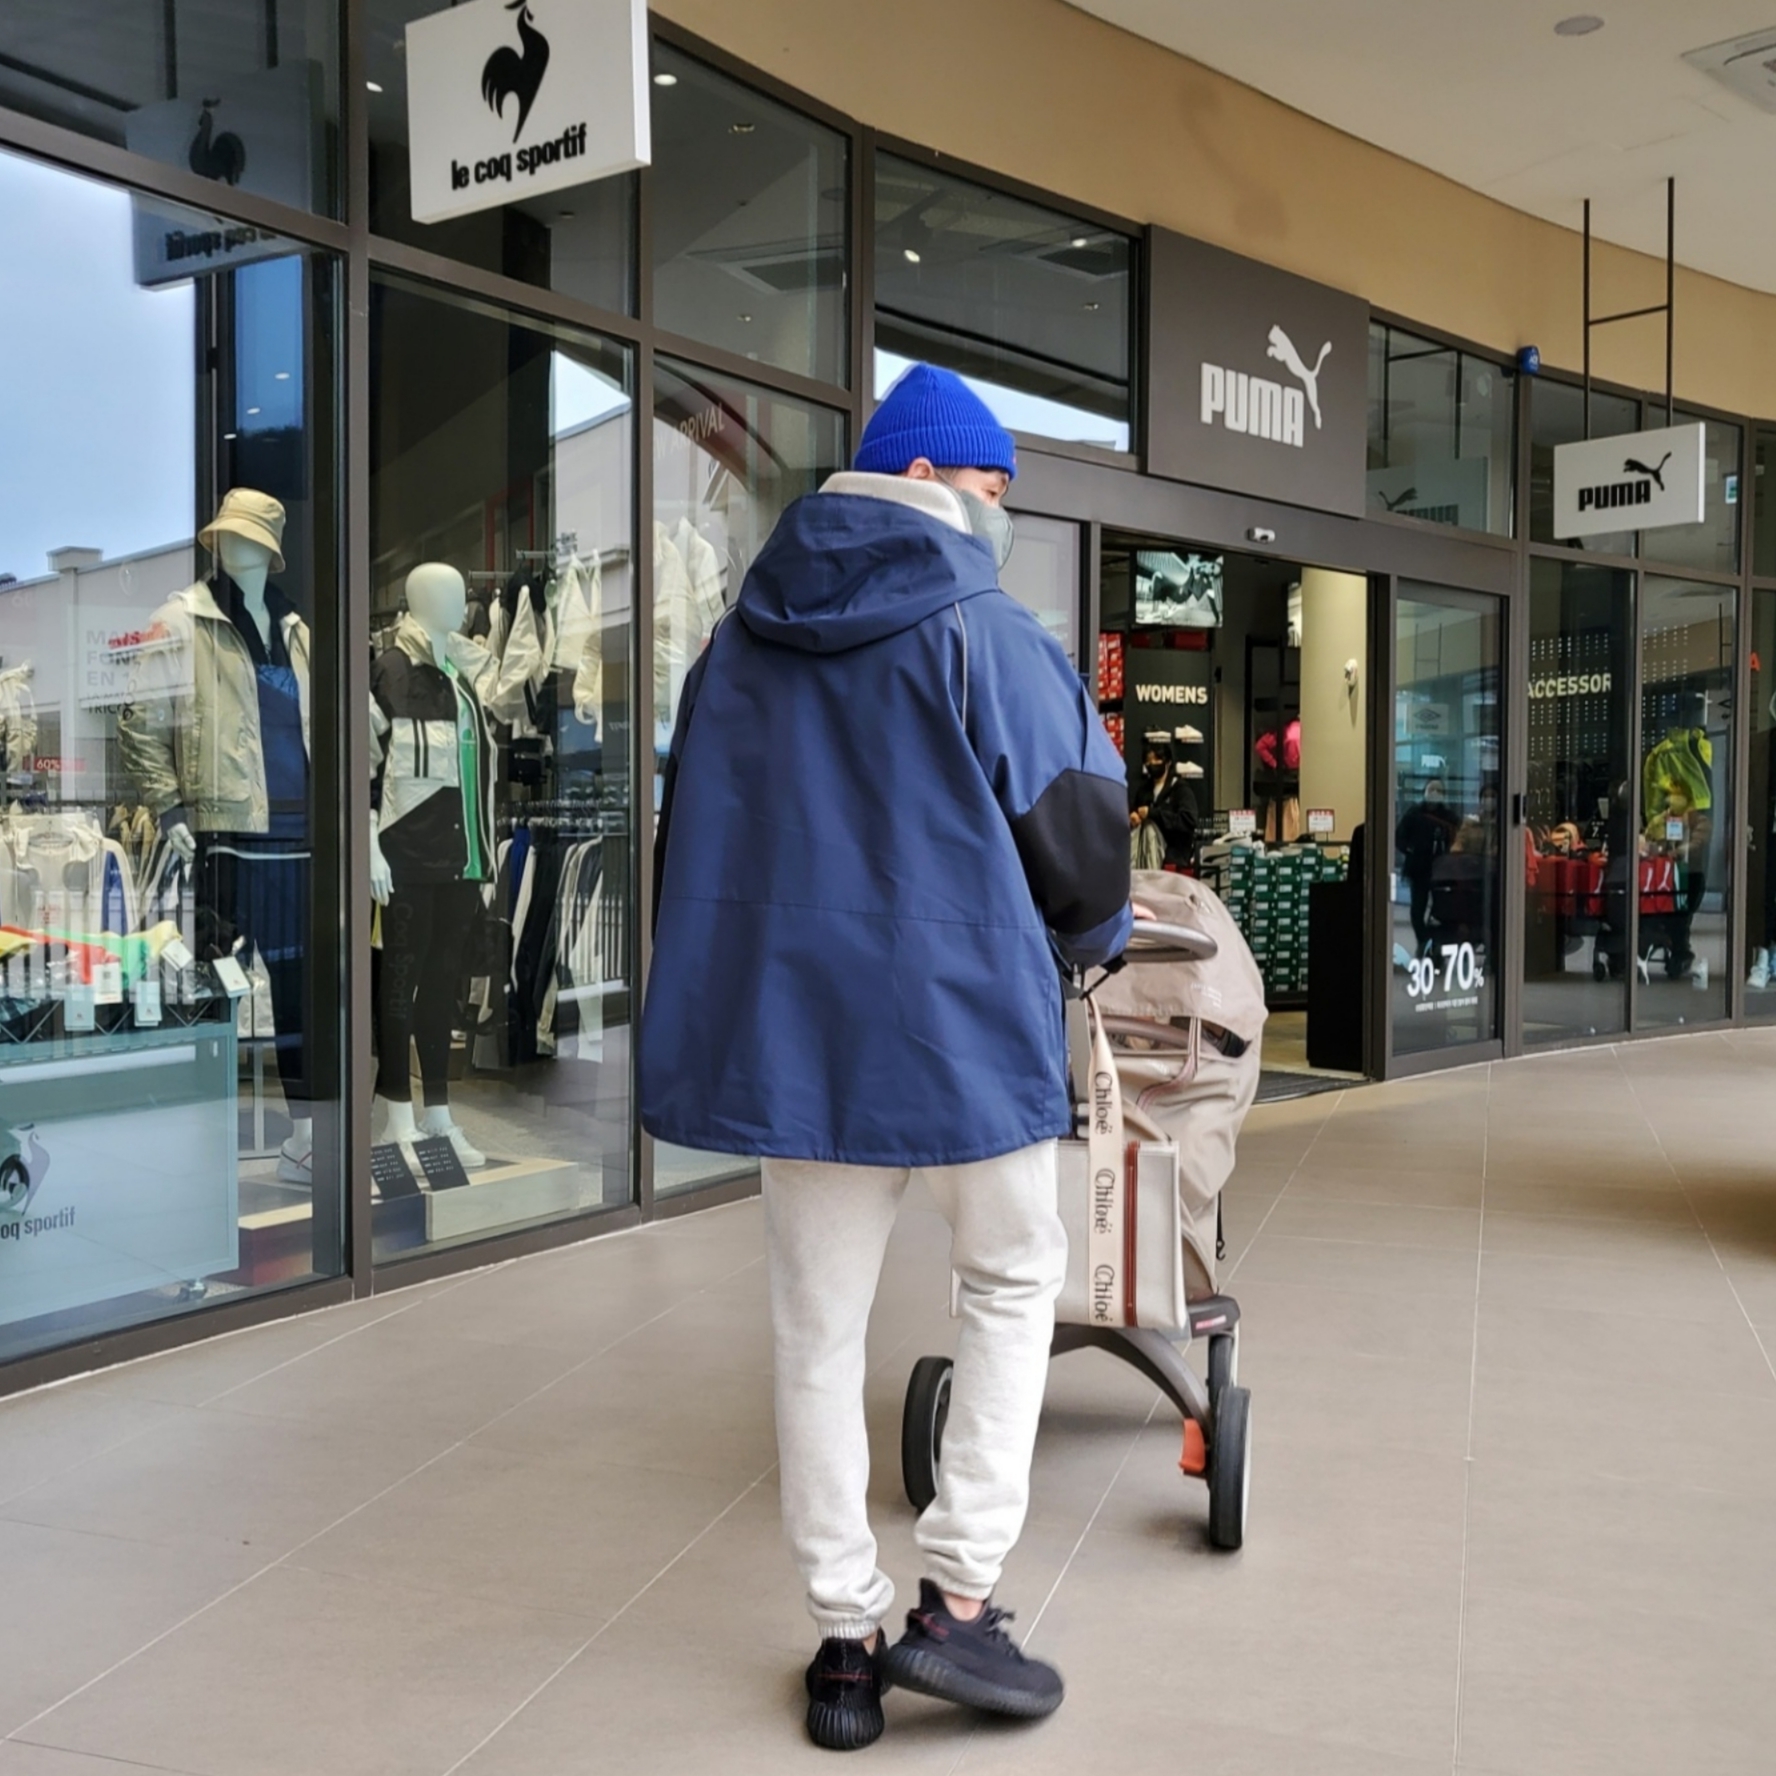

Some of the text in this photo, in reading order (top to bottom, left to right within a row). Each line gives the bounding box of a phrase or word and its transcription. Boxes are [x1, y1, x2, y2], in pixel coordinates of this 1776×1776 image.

[451, 122, 587, 190] le coq sportif
[1201, 362, 1304, 448] PUMA
[1578, 479, 1651, 512] PUMA
[1135, 684, 1208, 705] WOMENS
[24, 1205, 76, 1237] sportif
